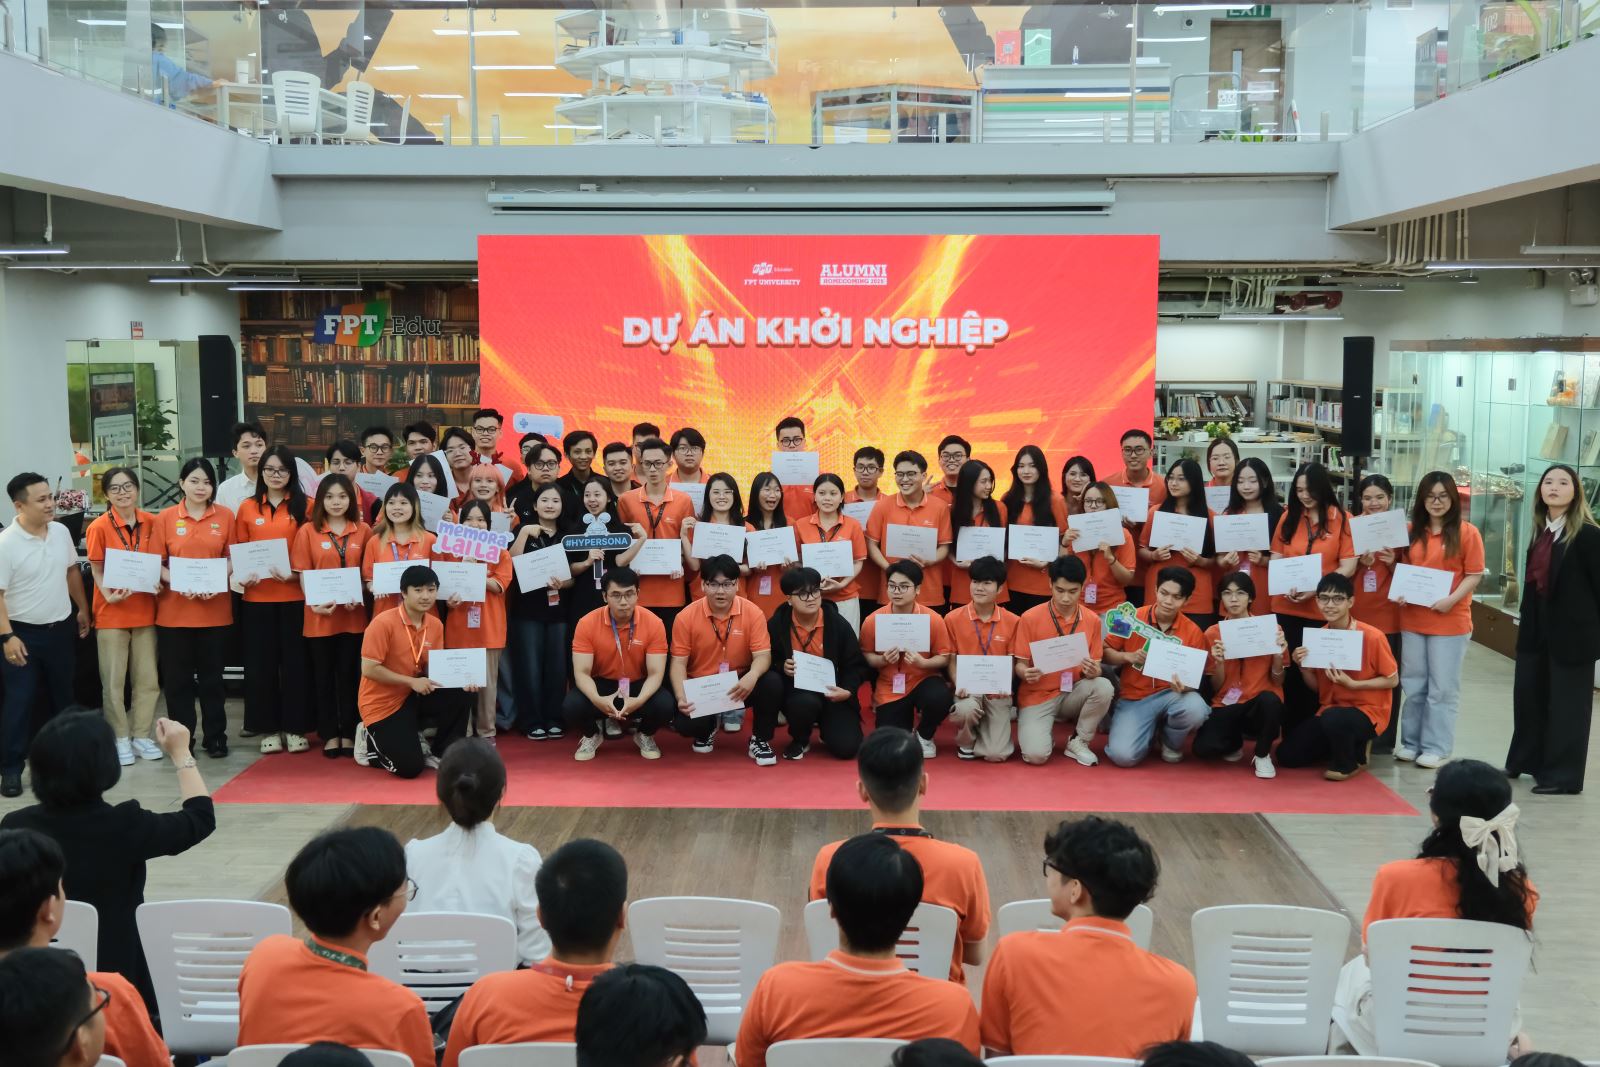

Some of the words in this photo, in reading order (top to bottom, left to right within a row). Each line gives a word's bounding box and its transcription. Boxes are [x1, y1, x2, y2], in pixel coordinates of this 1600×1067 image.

[820, 264, 888, 277] ALUMNI
[323, 314, 378, 335] FPT
[391, 315, 440, 336] Edu
[622, 312, 682, 353] DỰ
[688, 310, 745, 348] ÁN
[756, 307, 853, 348] KHỞI
[863, 310, 1010, 354] NGHIỆP
[565, 537, 629, 548] #HYPERSONA
